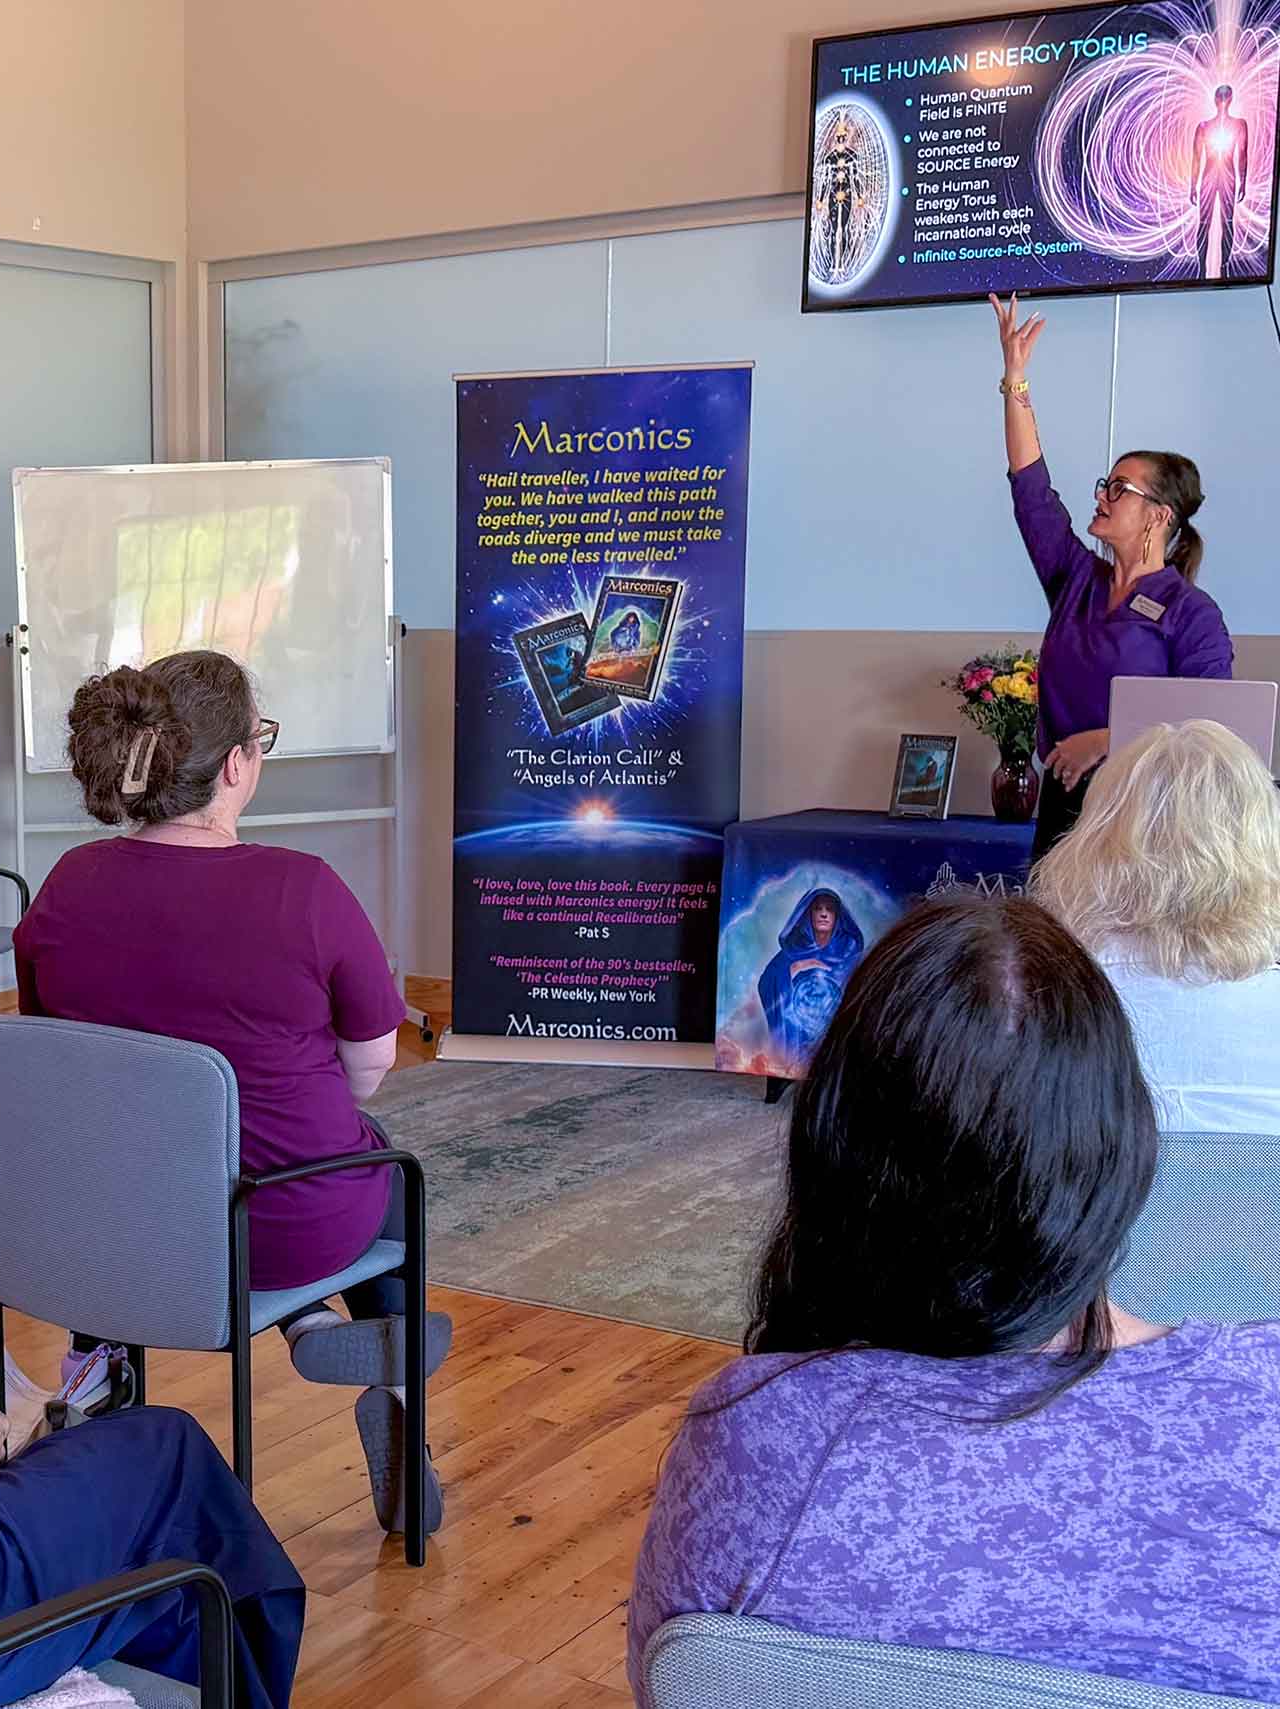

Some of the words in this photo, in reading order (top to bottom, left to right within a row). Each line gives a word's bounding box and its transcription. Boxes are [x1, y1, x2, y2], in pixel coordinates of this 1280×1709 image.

[841, 64, 881, 85] THE
[887, 54, 968, 80] HUMAN
[975, 42, 1065, 70] ENERGY
[1071, 33, 1147, 58] TORUS
[920, 91, 967, 106] Human
[970, 84, 1032, 101] Quantum
[919, 106, 949, 121] Field
[953, 106, 962, 118] is
[965, 101, 1007, 117] FINITE
[919, 129, 939, 142] We
[942, 129, 962, 140] are
[965, 125, 986, 137] not
[917, 140, 984, 158] connected
[987, 141, 1000, 151] to
[917, 158, 971, 174] SOURCE
[974, 155, 1019, 169] Energy
[916, 183, 939, 195] The
[942, 179, 990, 192] Human
[915, 198, 959, 211] Energy
[962, 194, 997, 206] Torus
[914, 212, 969, 226] weakens
[972, 208, 1000, 222] with
[1003, 205, 1034, 219] each
[914, 223, 995, 242] incarnational
[998, 222, 1031, 238] cycle
[913, 250, 956, 263] Infinite
[958, 244, 1031, 260] Source-Fed
[1034, 240, 1082, 256] System
[510, 419, 693, 458] Marconics
[478, 472, 517, 488] “Hail
[520, 470, 589, 487] traveller,
[594, 470, 600, 484] I
[603, 469, 640, 484] have
[645, 466, 699, 482] waited
[701, 465, 726, 482] for
[484, 493, 516, 510] you.
[521, 491, 543, 506] We
[546, 490, 583, 505] have
[587, 488, 644, 504] walked
[647, 487, 675, 502] this
[679, 485, 717, 504] path
[477, 512, 545, 530] together,
[548, 514, 577, 528] you
[580, 509, 611, 524] and
[613, 509, 623, 525] I,
[628, 508, 658, 523] and
[661, 509, 694, 522] now
[698, 506, 724, 521] the
[478, 531, 520, 546] roads
[524, 529, 581, 549] diverge
[584, 528, 615, 544] and
[618, 530, 640, 543] we
[644, 527, 683, 542] must
[687, 526, 722, 541] take
[511, 550, 536, 564] the
[539, 552, 568, 564] one
[571, 548, 600, 564] less
[606, 579, 673, 594] Marconics
[527, 623, 585, 650] Marconics
[506, 749, 546, 765] “The
[550, 749, 611, 765] Clarion
[668, 749, 684, 766] &
[513, 768, 575, 788] “Angels
[579, 769, 595, 788] of
[598, 768, 676, 785] Atlantis”
[485, 879, 514, 891] love,
[516, 879, 545, 892] love,
[547, 879, 572, 891] love
[574, 879, 597, 892] this
[599, 880, 633, 893] book.
[636, 881, 670, 895] Every
[672, 883, 704, 896] page
[706, 881, 717, 894] is
[480, 892, 521, 905] infused
[526, 893, 552, 906] with
[554, 894, 615, 908] Marconics
[617, 896, 663, 910] energy!
[666, 896, 676, 908] It
[678, 896, 708, 909] feels
[502, 909, 524, 921] like
[526, 911, 534, 921] a
[536, 909, 593, 922] continual
[574, 926, 599, 938] -Pat
[602, 927, 610, 938] S
[570, 957, 585, 970] of
[585, 958, 605, 970] the
[607, 958, 631, 970] 90's
[633, 959, 696, 973] bestseller,
[544, 972, 598, 985] Celestine
[528, 988, 549, 999] -PR
[551, 988, 597, 1003] Weekly,
[599, 989, 627, 1001] New
[629, 990, 656, 1002] York
[506, 1013, 678, 1041] Marconics.com
